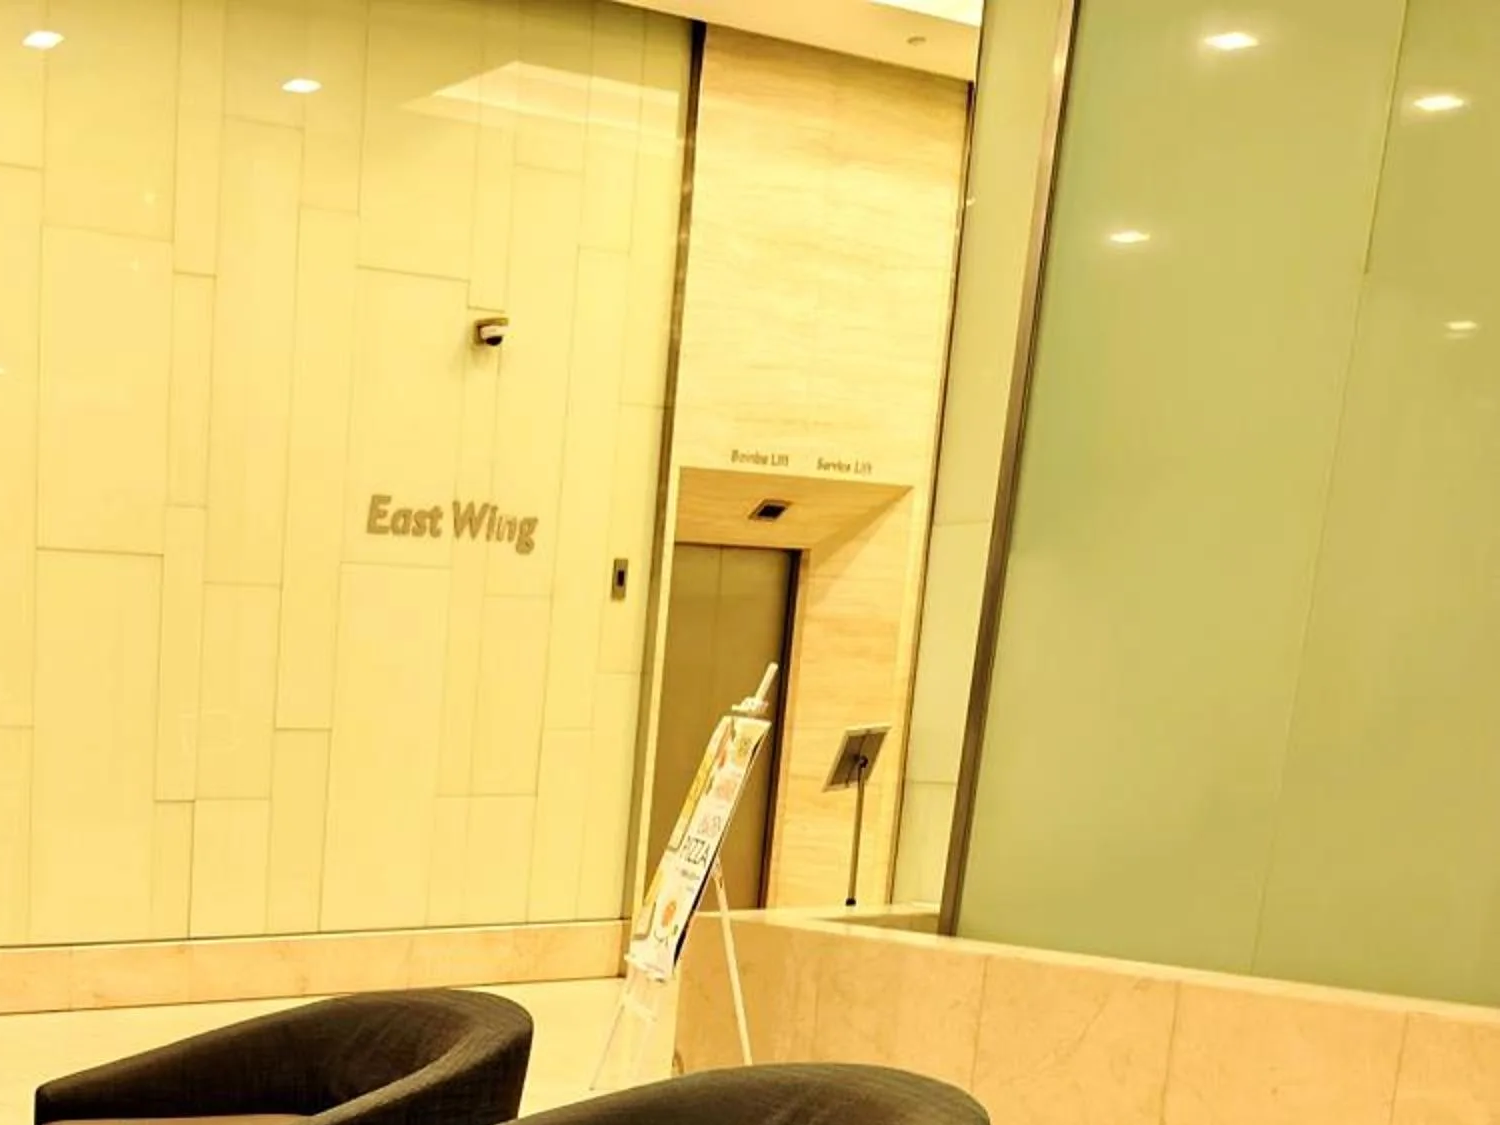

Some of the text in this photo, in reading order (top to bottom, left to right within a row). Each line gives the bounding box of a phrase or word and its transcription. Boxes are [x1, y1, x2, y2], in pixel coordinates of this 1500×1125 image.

[816, 457, 872, 475] Service Lift
[366, 494, 539, 555] East Wing
